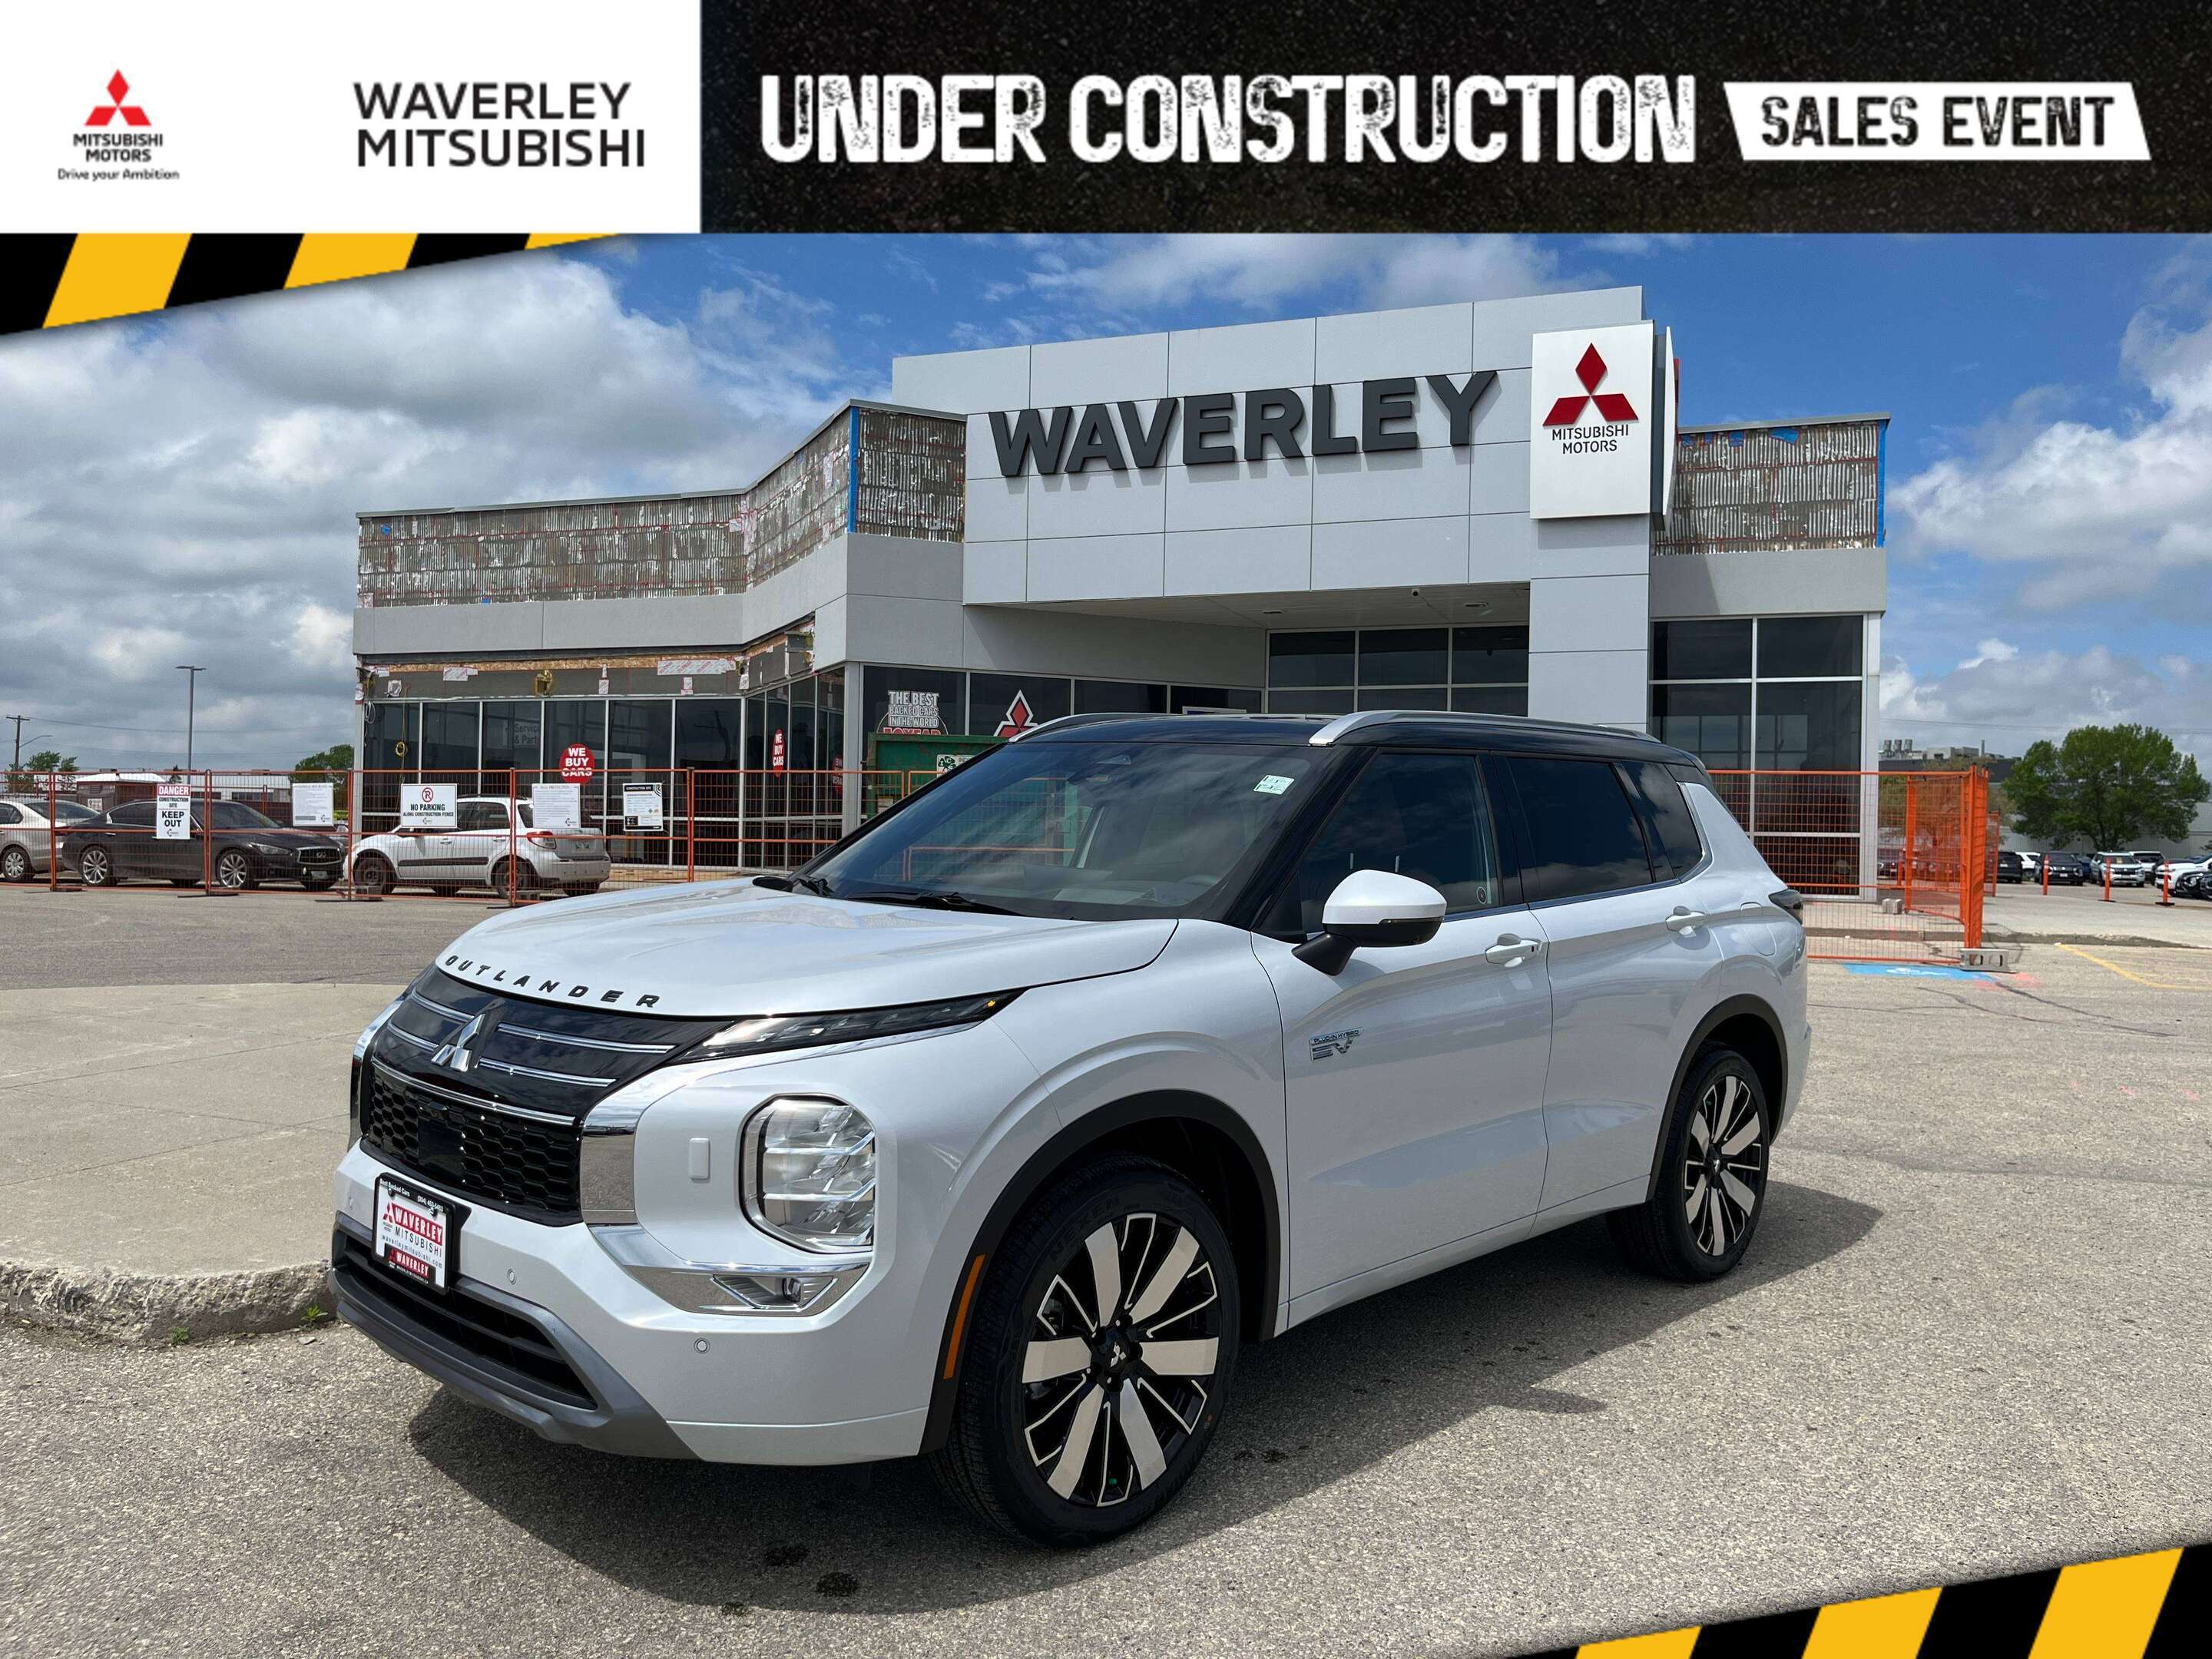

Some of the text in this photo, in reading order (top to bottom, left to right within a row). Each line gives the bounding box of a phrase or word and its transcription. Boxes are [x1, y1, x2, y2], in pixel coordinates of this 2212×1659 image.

[988, 370, 1497, 478] WAVERLEY
[1552, 425, 1629, 440] MITSUBISHI
[1563, 440, 1618, 454] MOTORS
[889, 691, 939, 707] THE BEST
[890, 706, 939, 717] BACKED CARS
[889, 716, 939, 727] IN THE WORLD
[568, 747, 586, 757] WE
[565, 757, 589, 767] BUY
[561, 768, 592, 777] CARS
[159, 786, 189, 795] DANGER
[445, 955, 660, 1008] OUTLANDER
[395, 1207, 442, 1243] WAVERLEY
[395, 1226, 442, 1258] MITSUBISHI
[396, 1251, 429, 1277] WAVERLEY
